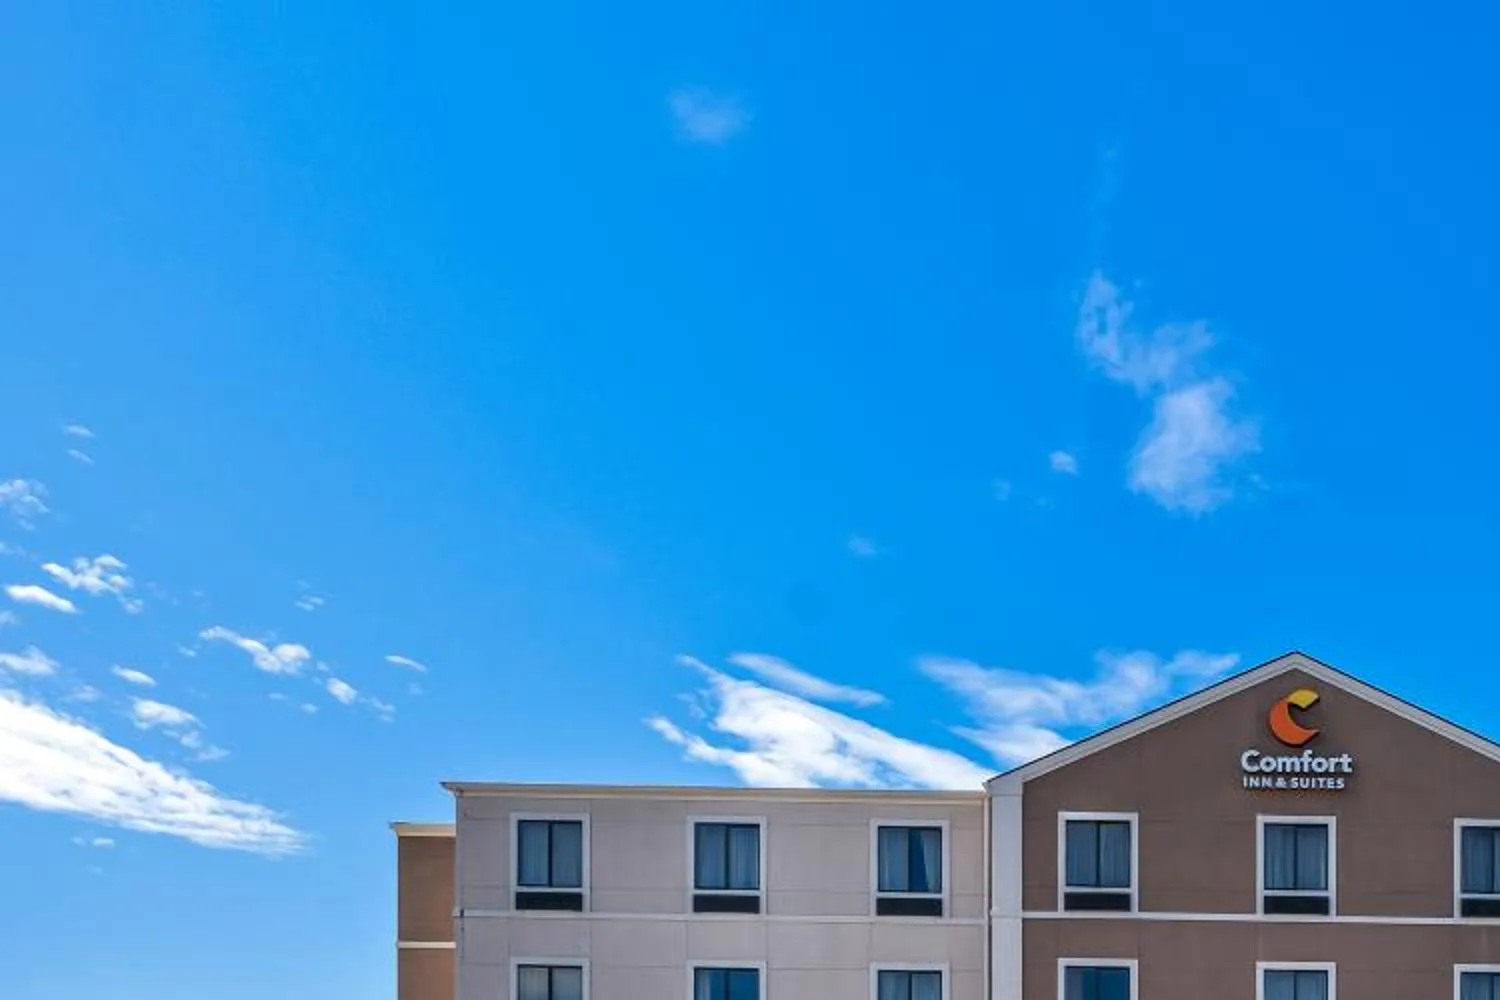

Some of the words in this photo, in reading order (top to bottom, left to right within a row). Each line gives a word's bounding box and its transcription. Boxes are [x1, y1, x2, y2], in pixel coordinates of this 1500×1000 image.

[1241, 749, 1353, 773] Comfort
[1243, 776, 1272, 788] INN
[1275, 777, 1288, 788] &
[1290, 777, 1345, 789] SUITES
